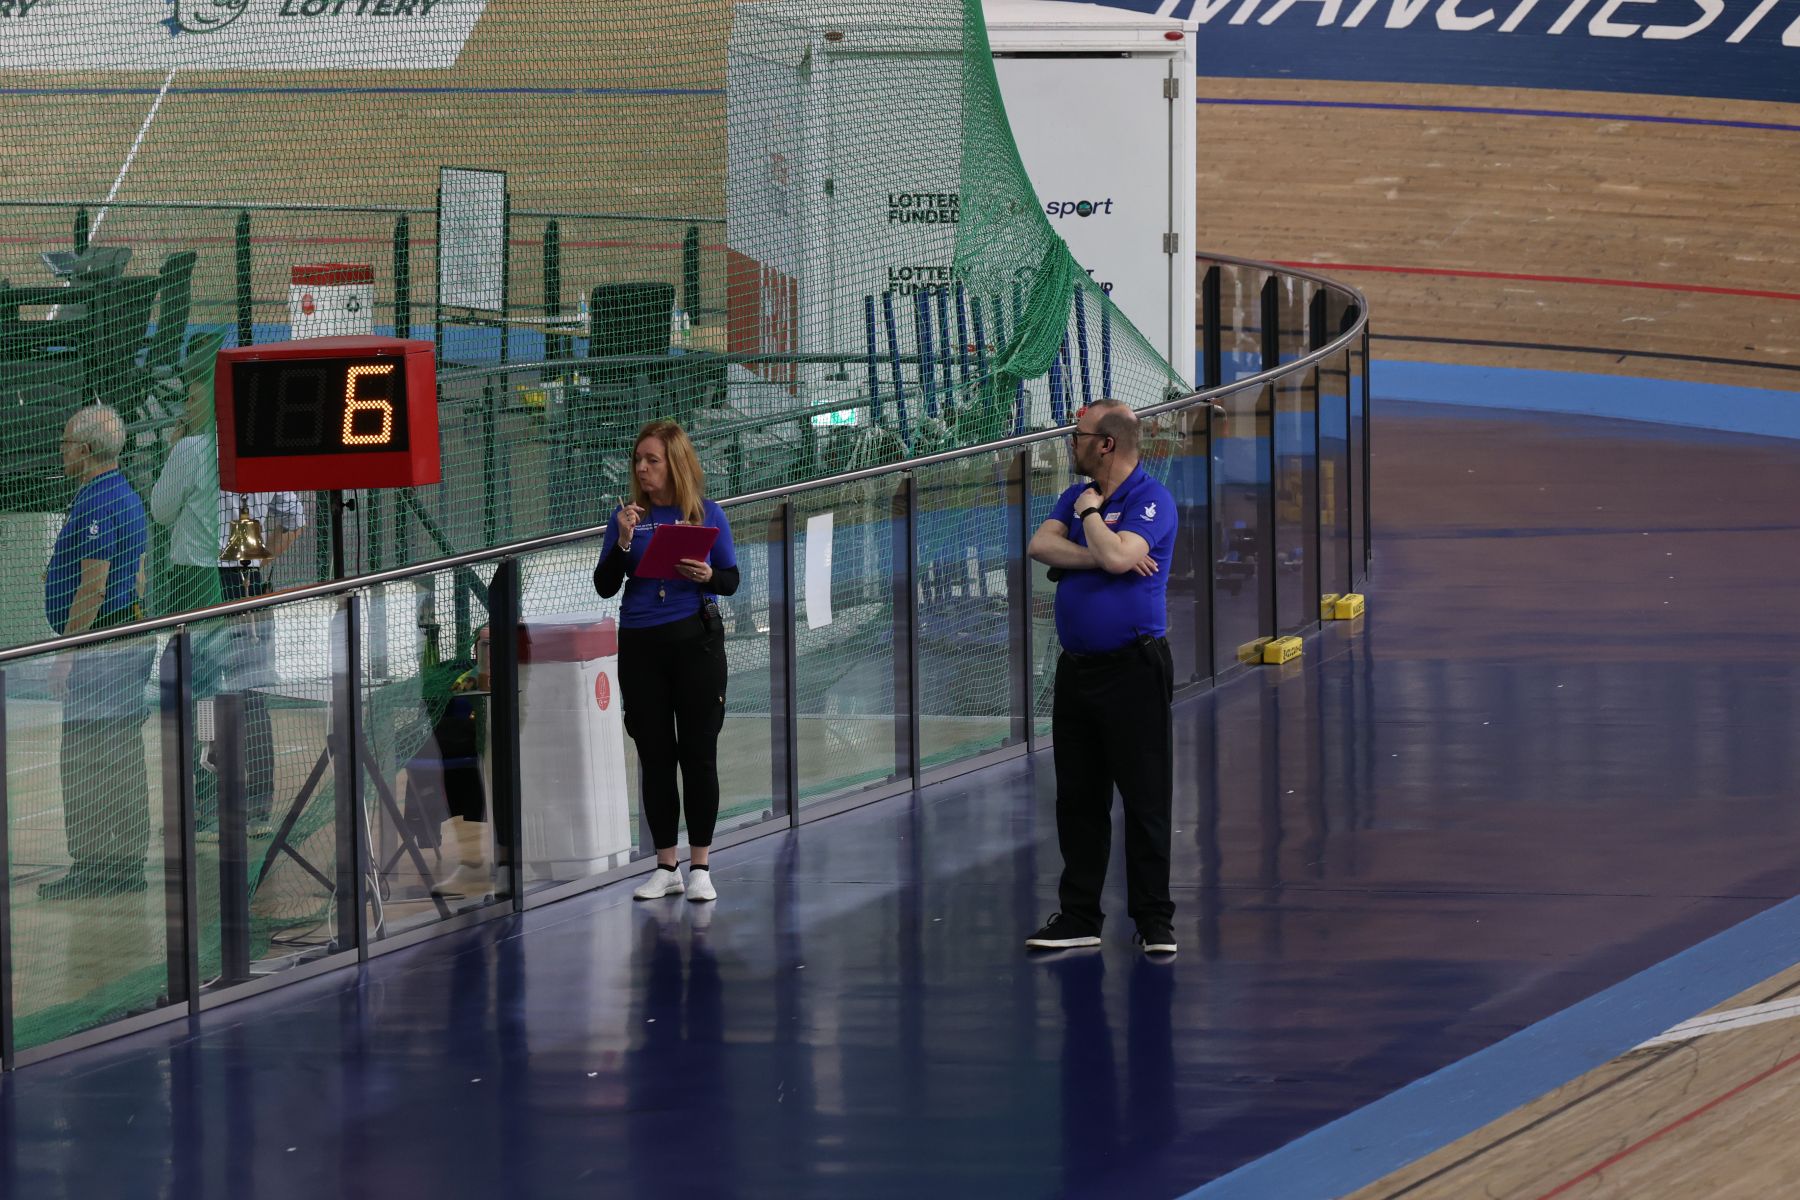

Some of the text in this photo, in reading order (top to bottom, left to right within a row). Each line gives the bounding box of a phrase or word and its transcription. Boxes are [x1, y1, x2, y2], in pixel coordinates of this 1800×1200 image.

[278, 0, 443, 17] LOTTERY
[888, 193, 961, 208] LOTTER
[1046, 198, 1113, 219] sport
[342, 364, 394, 445] 6
